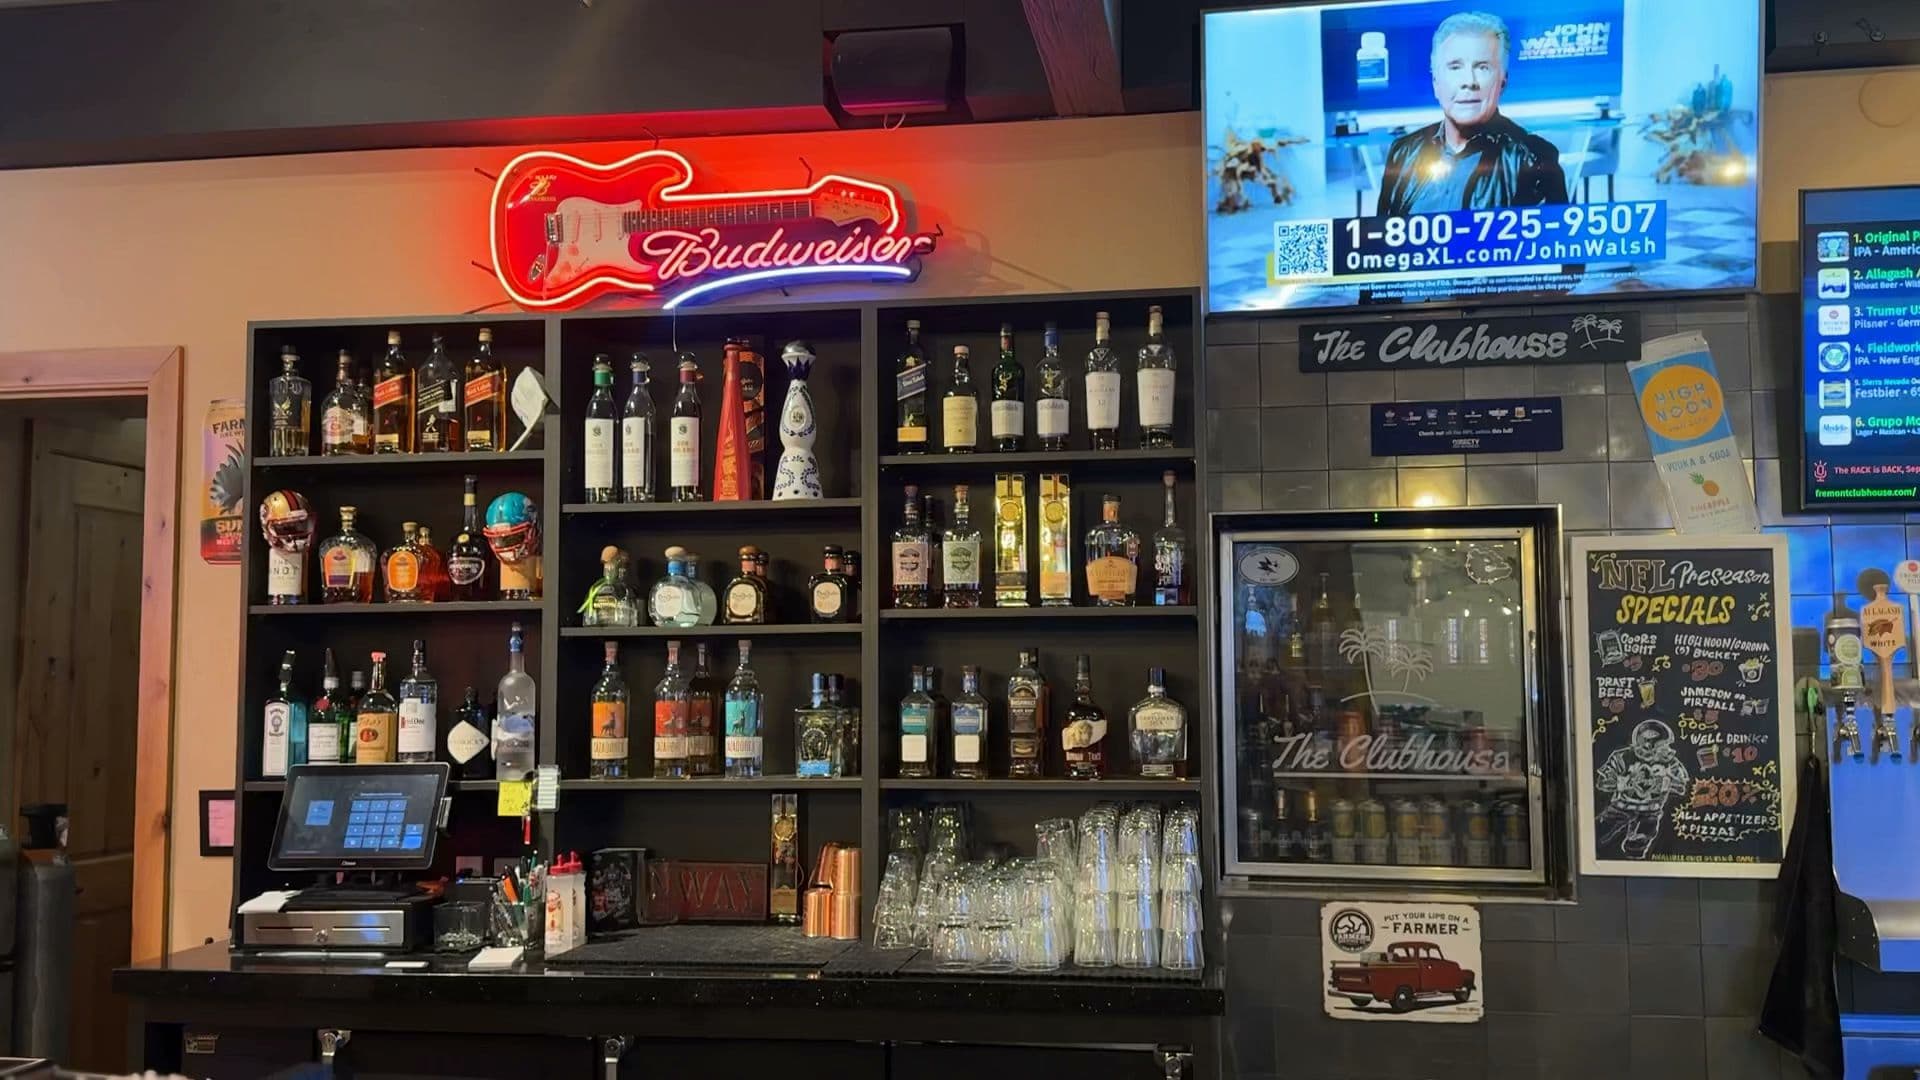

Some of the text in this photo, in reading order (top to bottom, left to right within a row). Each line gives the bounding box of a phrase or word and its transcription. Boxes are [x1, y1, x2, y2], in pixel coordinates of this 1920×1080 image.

[1544, 22, 1611, 38] JOHN
[1345, 203, 1656, 249] 1-800-725-9507
[1864, 229, 1909, 247] Original
[643, 228, 932, 281] Budweiser
[1346, 236, 1656, 270] OmegaXL.com/JohnWalsh
[1854, 245, 1871, 257] IPA
[1865, 267, 1912, 282] Allagash
[1866, 306, 1907, 317] Trumer
[1854, 319, 1887, 331] Pilsner
[1313, 325, 1569, 370] The Clubhouse
[1855, 355, 1870, 366] IPA
[1879, 354, 1900, 365] New
[1655, 383, 1706, 405] HIGH
[1855, 386, 1902, 400] Festbier
[1655, 398, 1714, 424] NOON
[1867, 415, 1903, 431] Grupo
[1834, 466, 1849, 475] The
[1814, 487, 1917, 501] fremontclubhouse.com/
[1598, 559, 1771, 594] NFL Preseason
[1616, 595, 1736, 625] SPECIALS
[1674, 633, 1771, 653] HIGH NOON/CORONA
[1692, 649, 1741, 660] BUCKET
[1596, 677, 1636, 689] DRAFT
[1598, 687, 1635, 699] BEER
[1680, 686, 1731, 700] JAMESON
[1683, 698, 1736, 712] FIREBALL
[1690, 732, 1769, 746] WELL DRINKS
[1271, 731, 1510, 771] The Clubhouse
[1678, 811, 1777, 826] ALL APPETIZERS
[1690, 824, 1736, 837] PIZZAS
[1384, 911, 1470, 925] PUT YOUR LIPS ON A
[1392, 922, 1459, 936] FARMER
